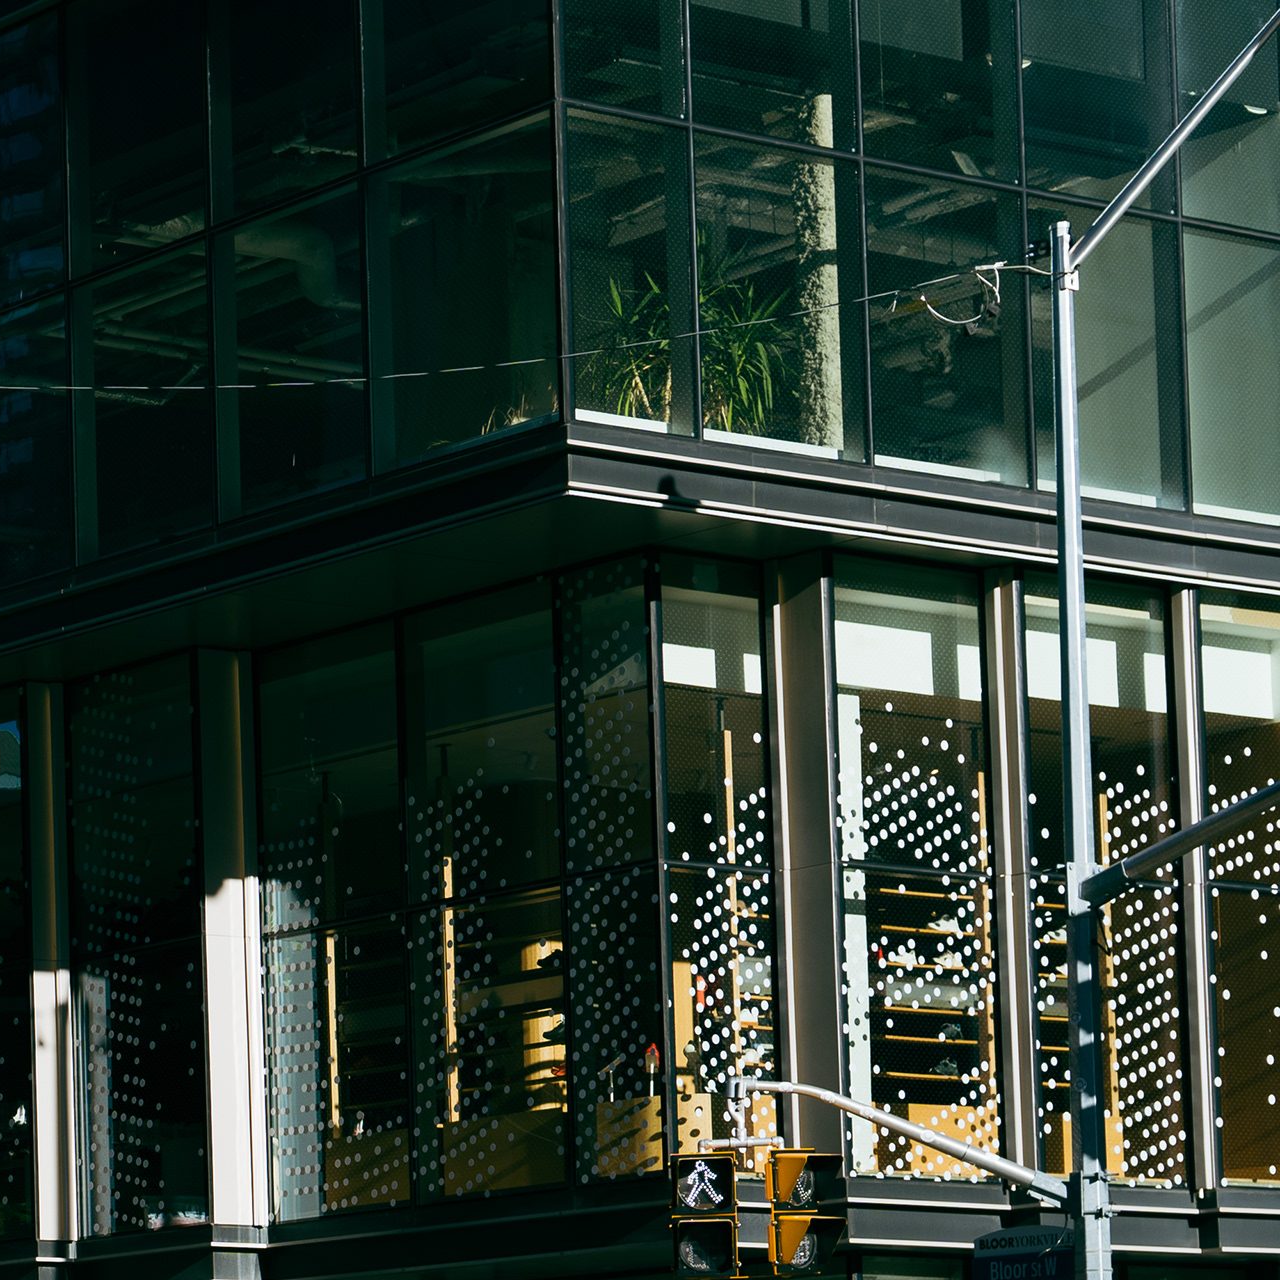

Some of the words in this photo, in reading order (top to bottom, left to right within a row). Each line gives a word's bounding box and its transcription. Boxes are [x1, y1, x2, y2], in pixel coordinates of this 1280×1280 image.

[979, 1232, 1074, 1250] BLOORYORKVILLE
[990, 1260, 1027, 1280] Bloor
[1031, 1261, 1042, 1278] St
[1045, 1256, 1057, 1276] W
